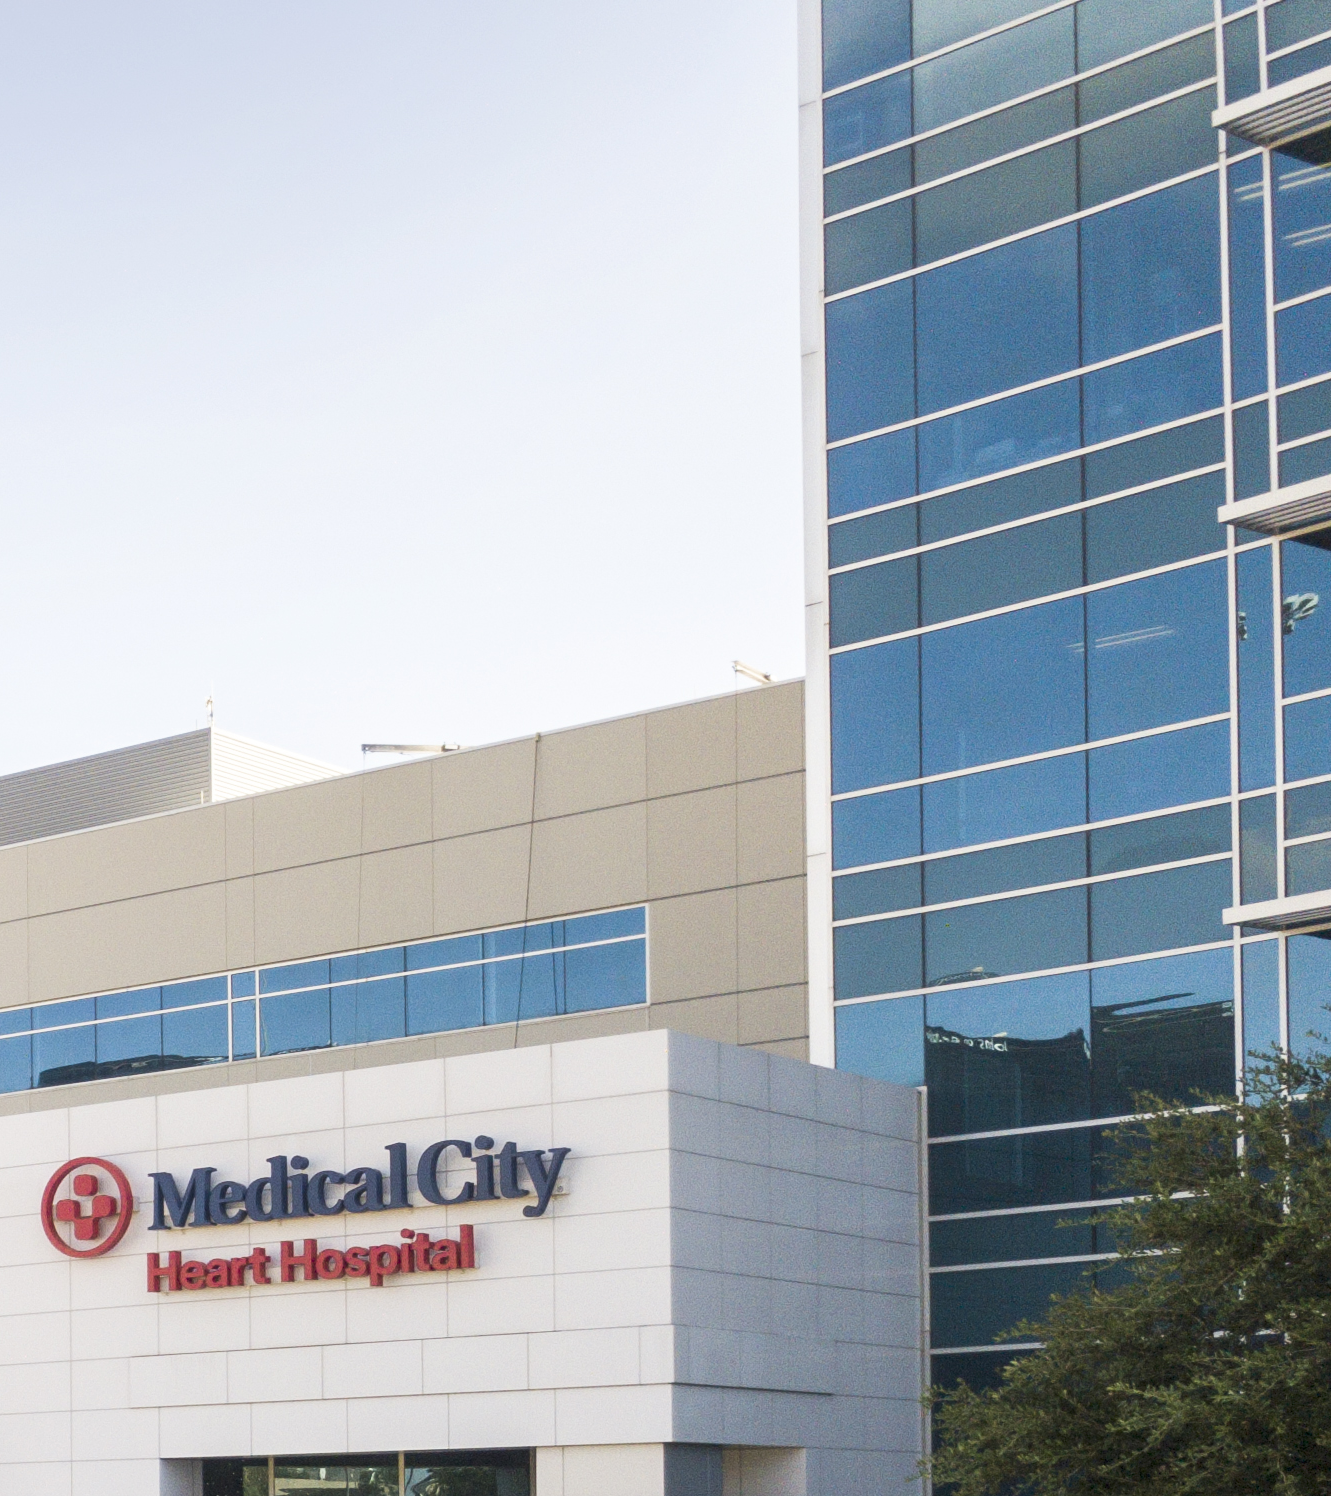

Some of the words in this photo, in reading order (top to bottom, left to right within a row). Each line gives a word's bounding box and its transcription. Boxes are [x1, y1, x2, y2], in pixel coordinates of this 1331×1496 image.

[147, 1141, 412, 1232] Medical
[417, 1134, 572, 1219] City
[147, 1247, 271, 1293] Heart
[280, 1223, 475, 1287] Hospital
